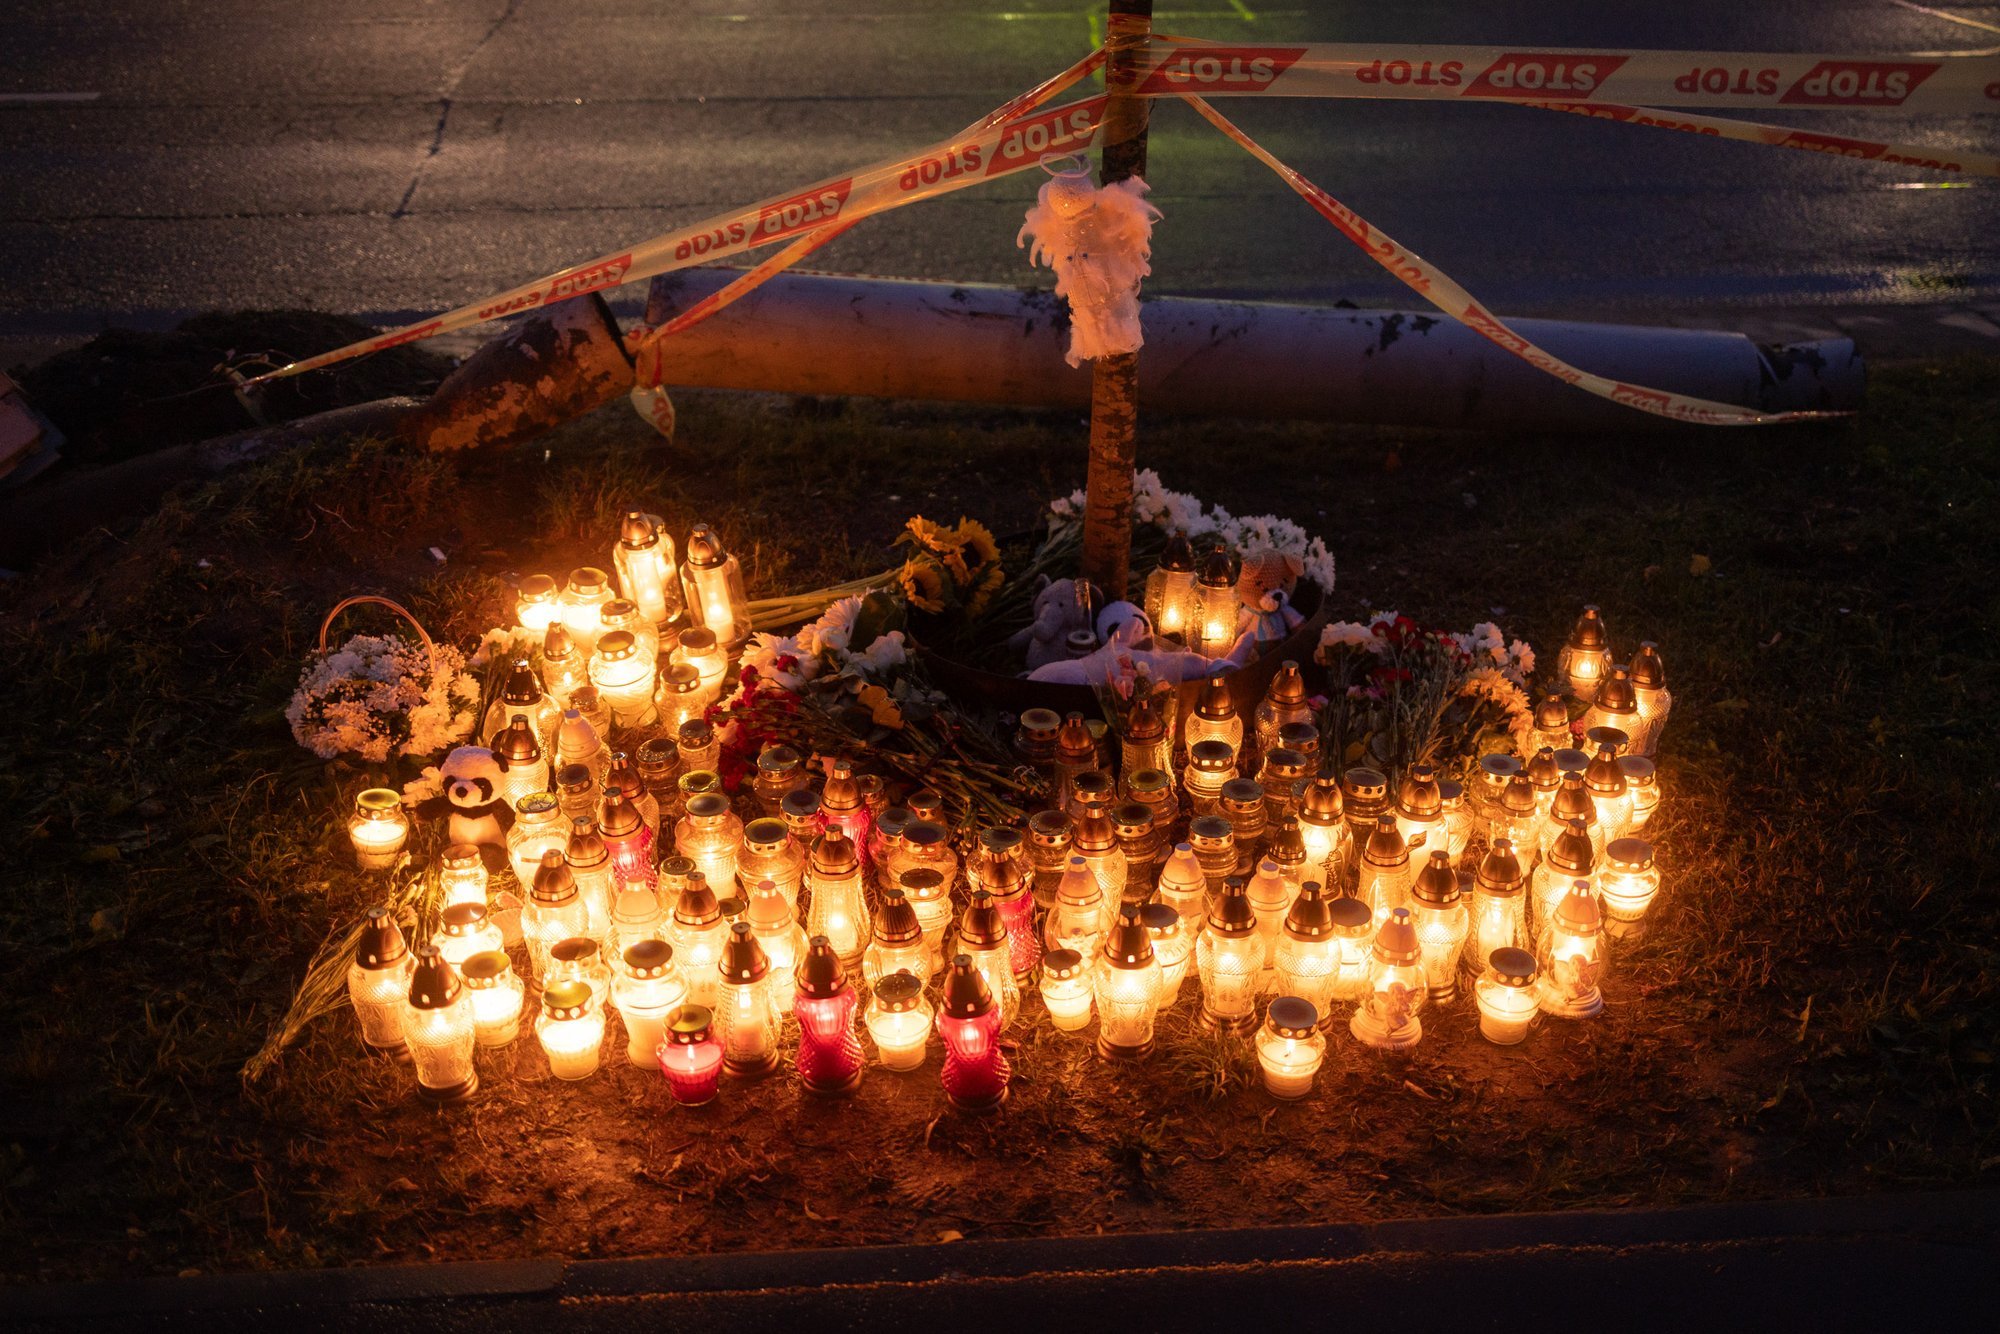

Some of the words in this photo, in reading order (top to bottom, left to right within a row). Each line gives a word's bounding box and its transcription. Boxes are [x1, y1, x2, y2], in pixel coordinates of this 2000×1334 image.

[1165, 57, 1275, 83] STOP
[1355, 60, 1464, 86] STOP
[1489, 62, 1597, 91] STOP
[1674, 68, 1780, 96] STOP
[1803, 70, 1910, 99] STOP
[1002, 109, 1094, 159] STOP
[900, 145, 982, 191] STOP
[763, 191, 839, 234] STOP
[675, 222, 746, 261] STOP
